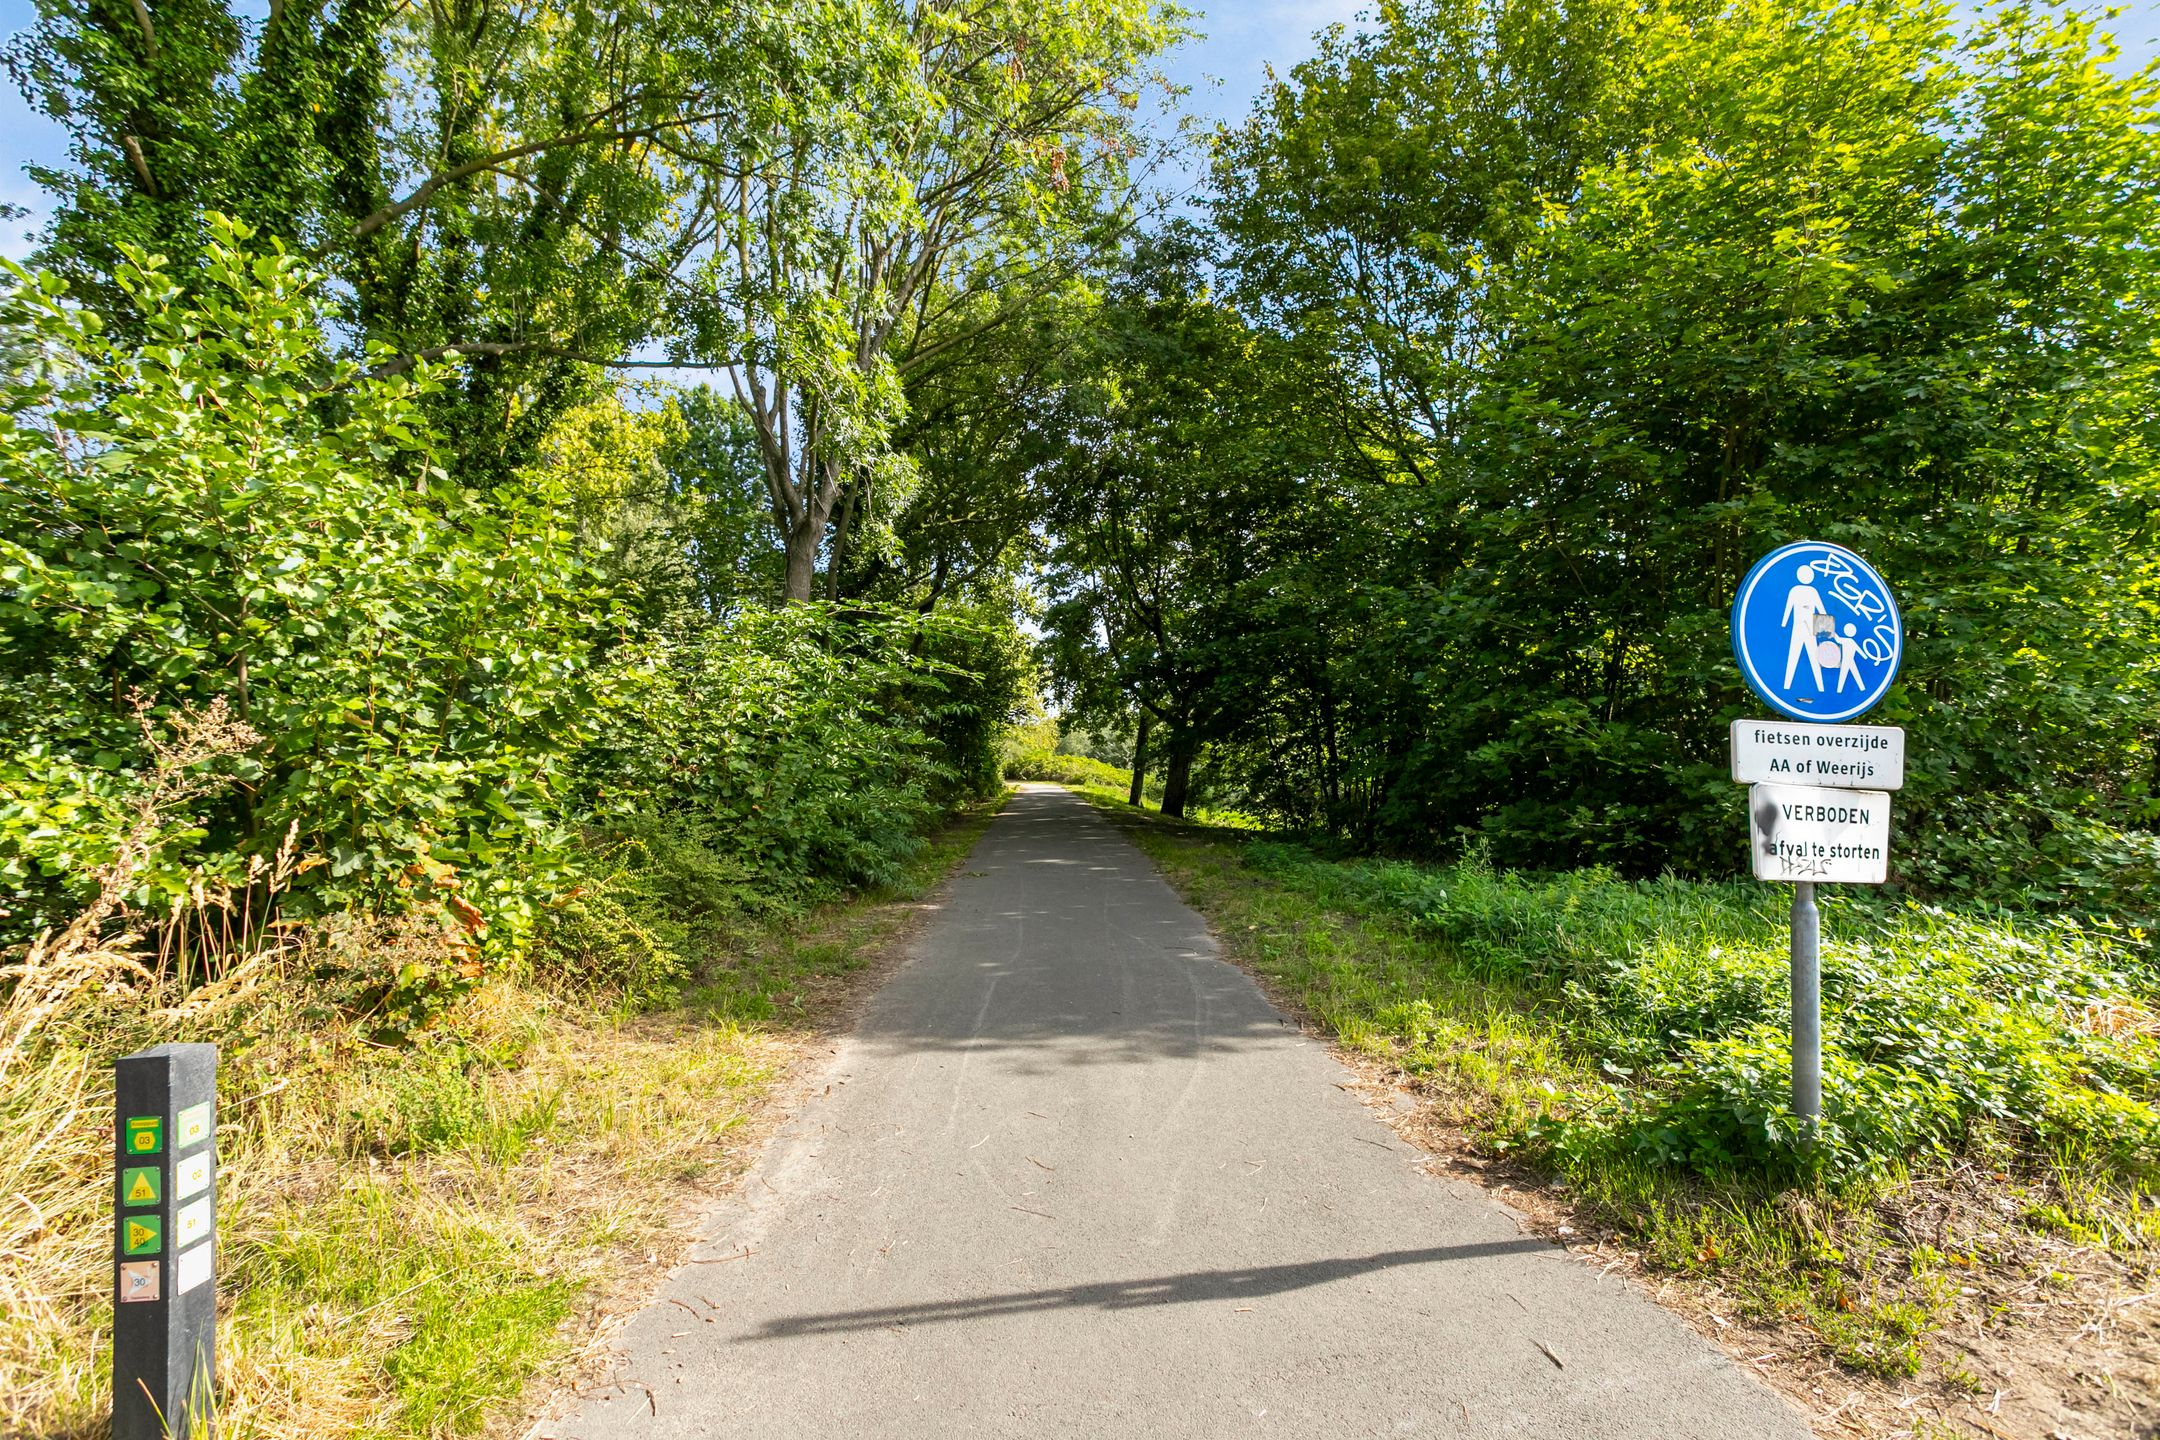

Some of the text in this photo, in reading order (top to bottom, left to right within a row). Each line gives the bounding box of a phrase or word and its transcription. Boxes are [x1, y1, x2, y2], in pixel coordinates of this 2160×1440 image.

[1754, 729, 1889, 752] fietsen overzijde
[1769, 758, 1875, 779] AA of Weerijs
[1782, 803, 1870, 825] VERBODEN
[1769, 840, 1880, 860] afval te storten
[139, 1136, 151, 1145] 03
[135, 1189, 146, 1198] 51
[133, 1228, 145, 1237] 30
[134, 1277, 146, 1287] 30
